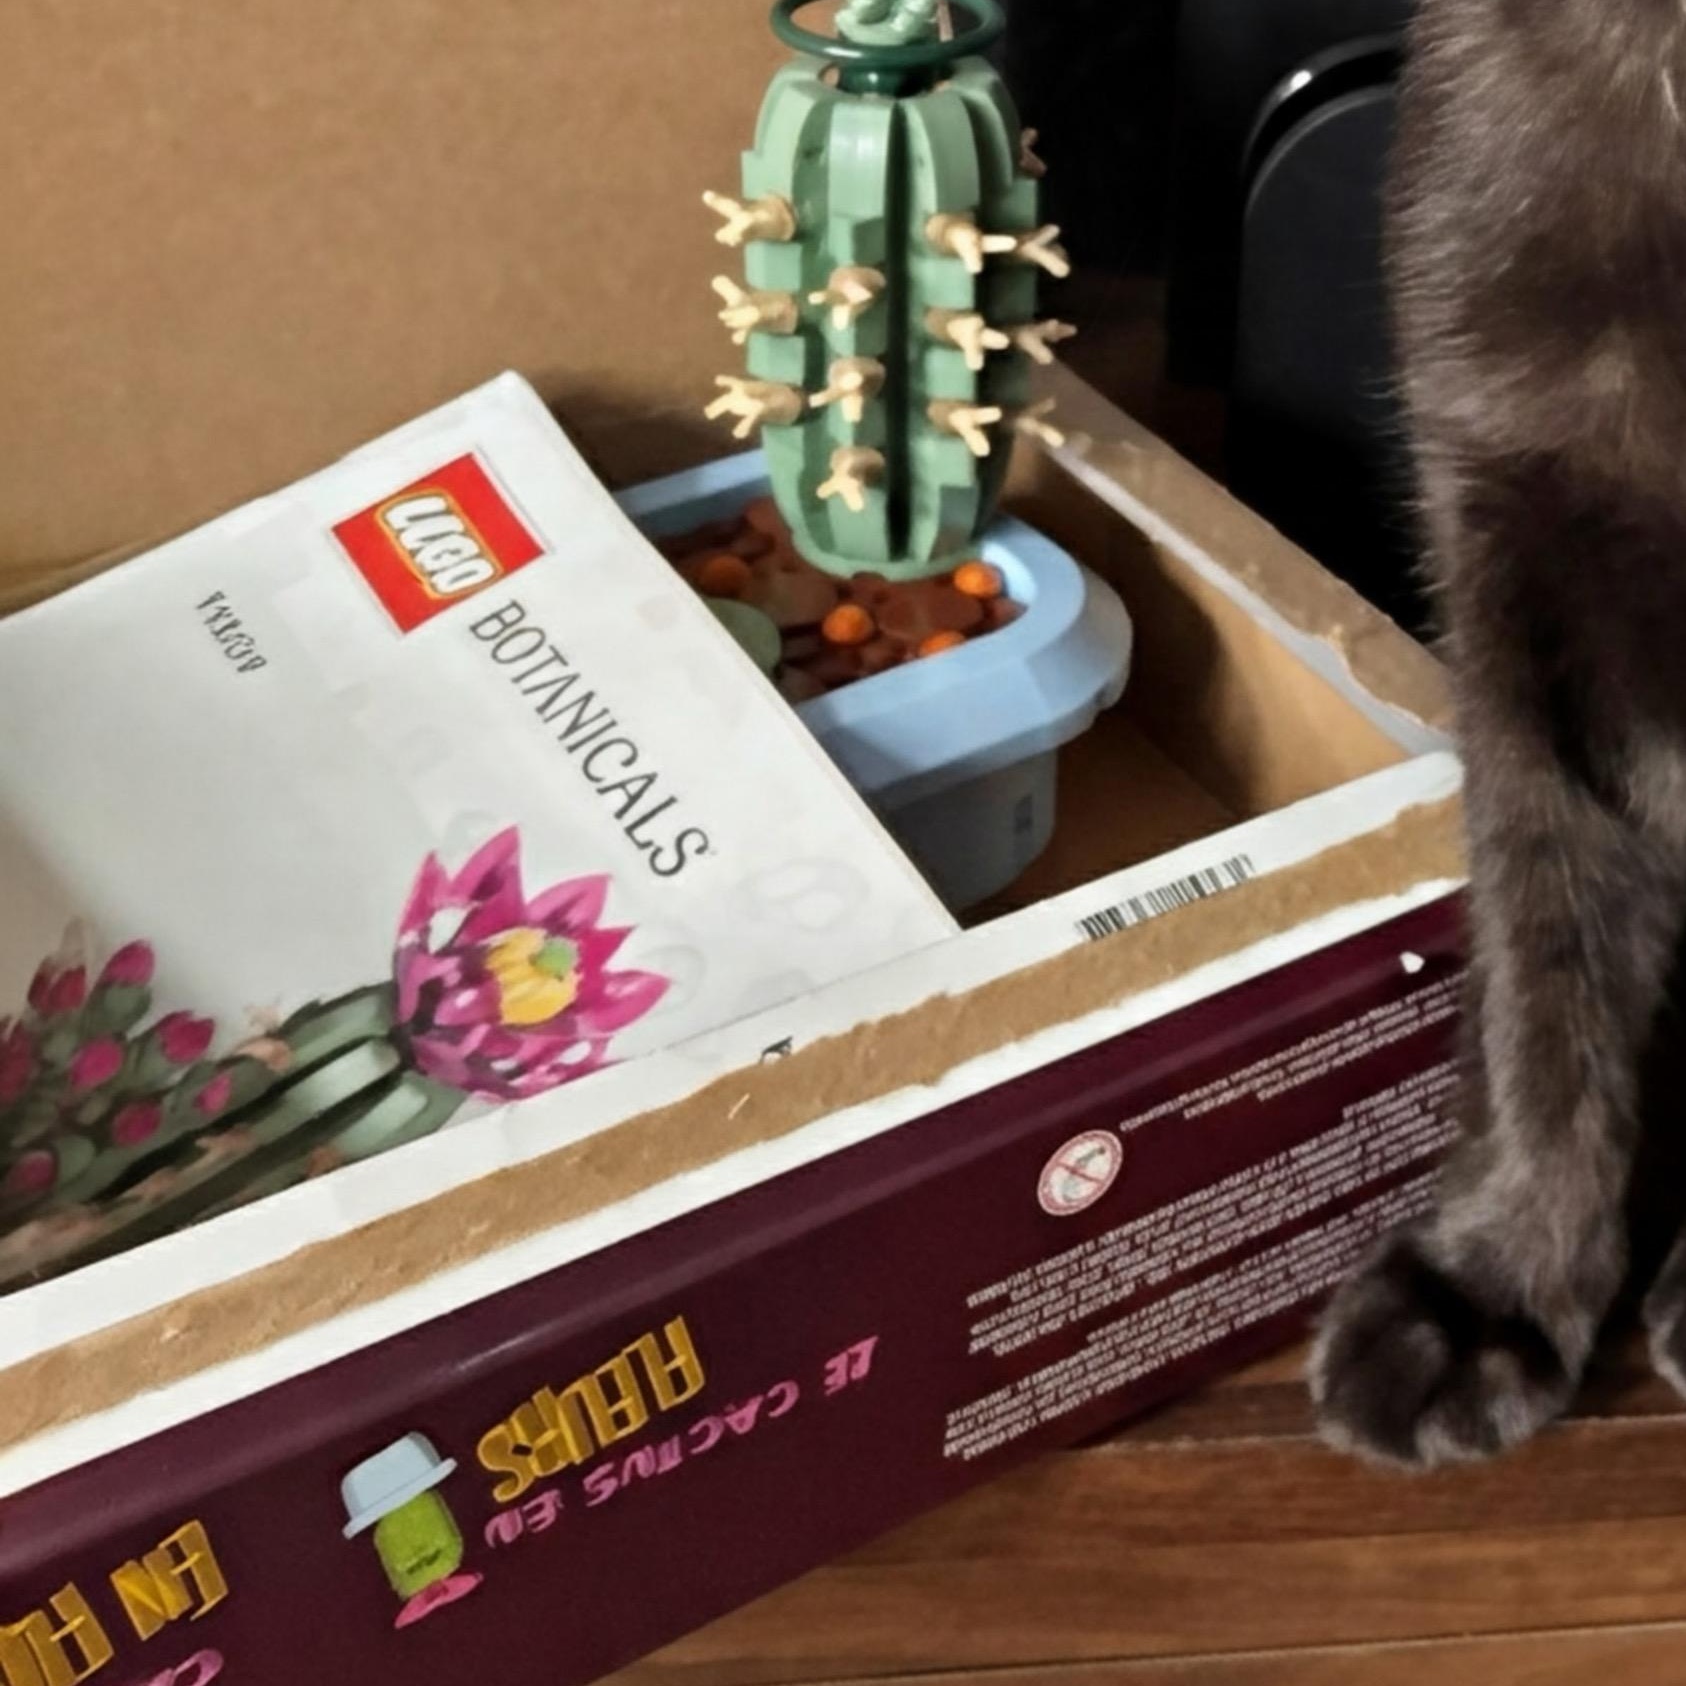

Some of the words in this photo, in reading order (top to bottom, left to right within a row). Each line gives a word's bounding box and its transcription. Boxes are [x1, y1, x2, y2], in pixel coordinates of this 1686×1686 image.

[378, 490, 502, 599] LEGO
[468, 599, 710, 878] BOTANICALS
[476, 1314, 706, 1503] FLEURS
[822, 1335, 880, 1396] LE
[582, 1379, 799, 1507] CACTUS
[109, 1518, 229, 1642] EN
[484, 1488, 564, 1549] EN
